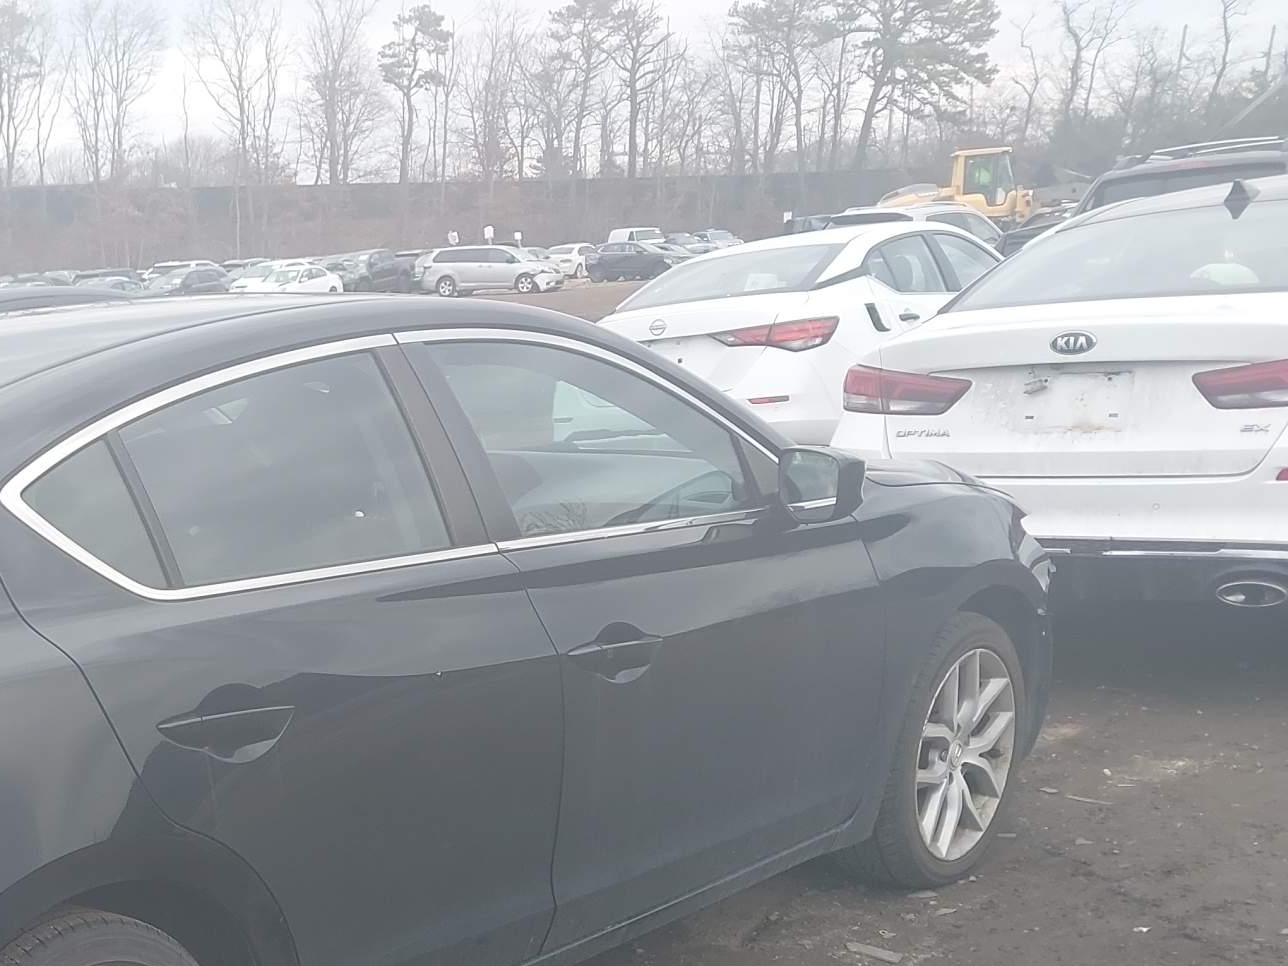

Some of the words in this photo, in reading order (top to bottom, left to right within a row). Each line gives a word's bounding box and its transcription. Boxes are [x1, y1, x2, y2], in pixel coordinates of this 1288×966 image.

[1056, 335, 1089, 350] KIA
[1240, 423, 1272, 433] EX
[895, 430, 951, 438] OPTIMA
